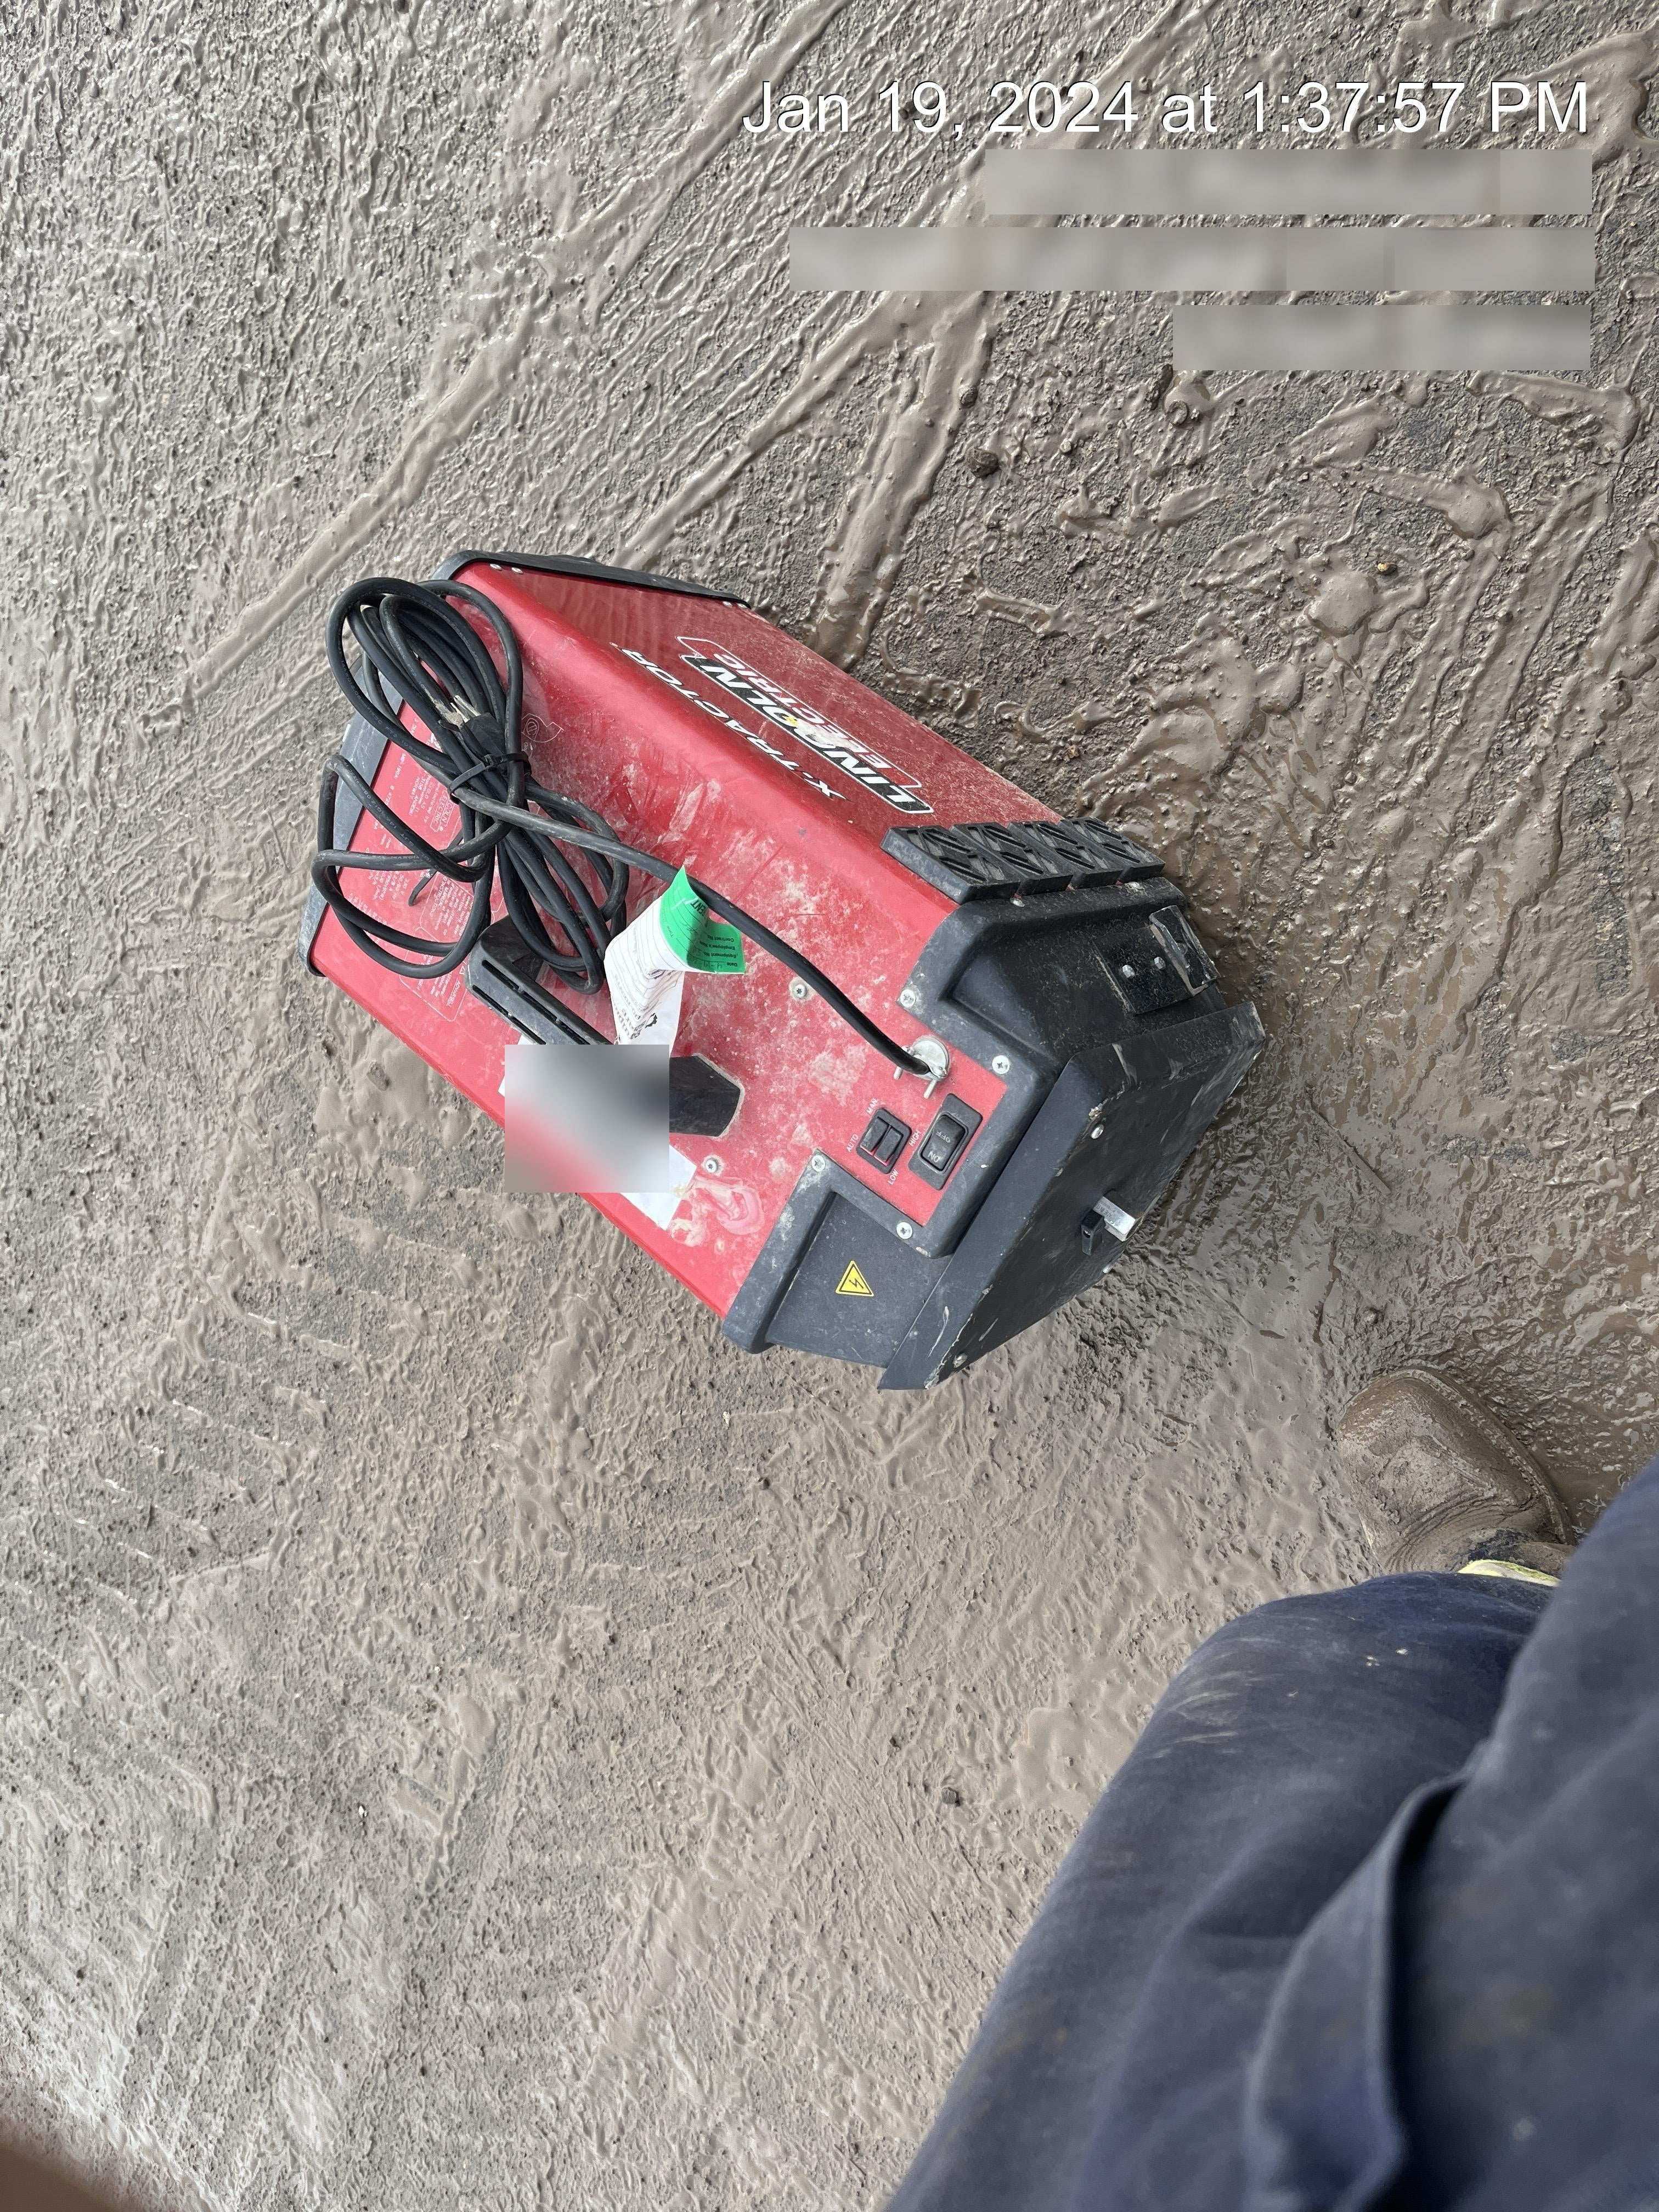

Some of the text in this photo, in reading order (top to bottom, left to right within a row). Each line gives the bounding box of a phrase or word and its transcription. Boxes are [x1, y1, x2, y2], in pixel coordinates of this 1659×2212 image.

[713, 653, 893, 769] ELECTRIC
[621, 648, 848, 799] X-TRACTOR
[699, 665, 916, 803] LINCOLN
[845, 1133, 859, 1153] AUTO
[909, 1130, 922, 1147] HIGH
[935, 1131, 951, 1143] OFF
[927, 1150, 941, 1164] ON
[887, 1169, 899, 1186] LOW
